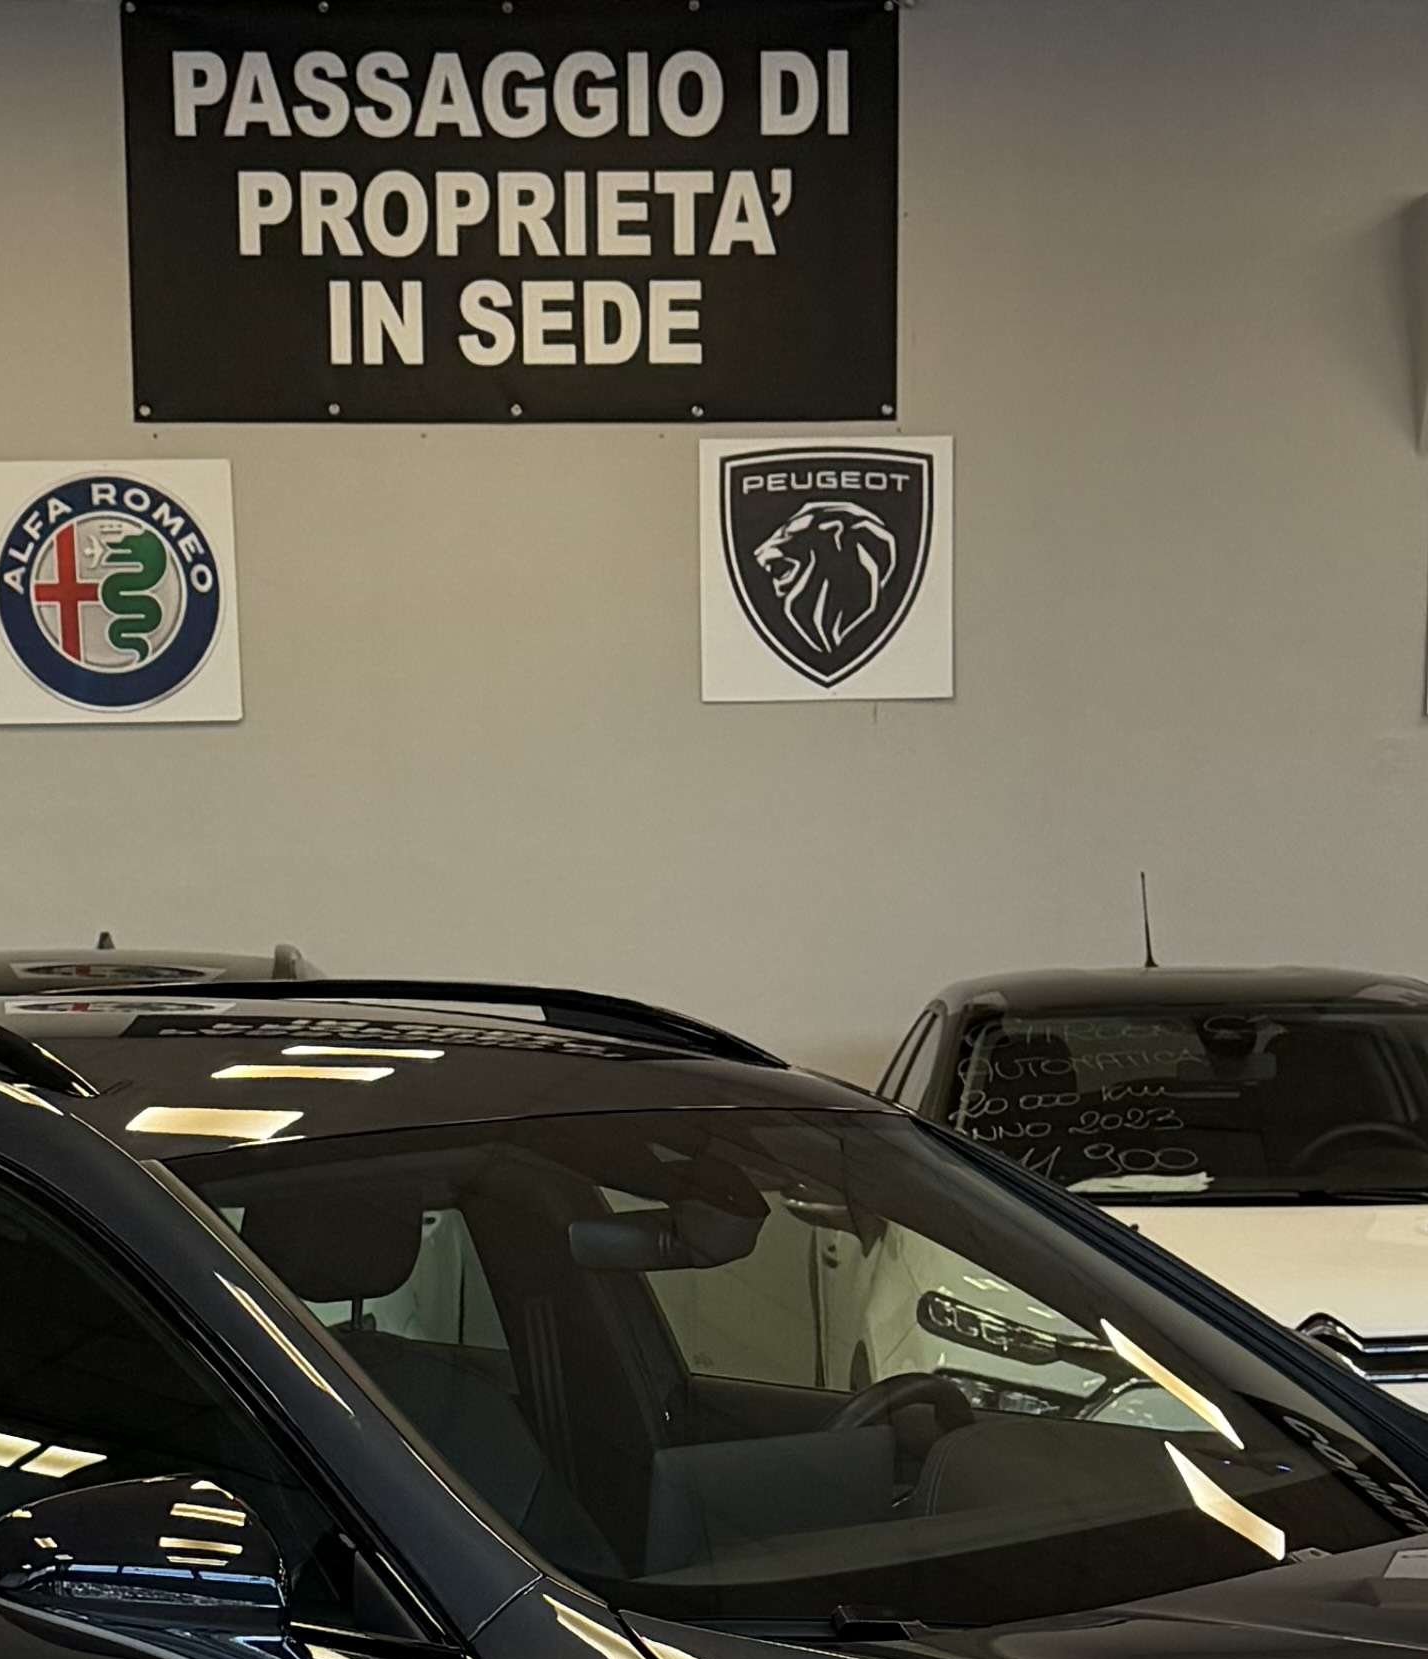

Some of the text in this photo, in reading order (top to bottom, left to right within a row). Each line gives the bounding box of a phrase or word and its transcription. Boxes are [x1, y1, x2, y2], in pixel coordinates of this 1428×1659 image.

[172, 49, 850, 138] PASSAGGIO DI
[237, 168, 793, 257] PROPRIETA'
[329, 279, 703, 365] IN SEDE
[742, 470, 911, 495] PEUGEOT
[3, 482, 214, 595] ALFA ROMEO
[1068, 1107, 1184, 1136] 2023
